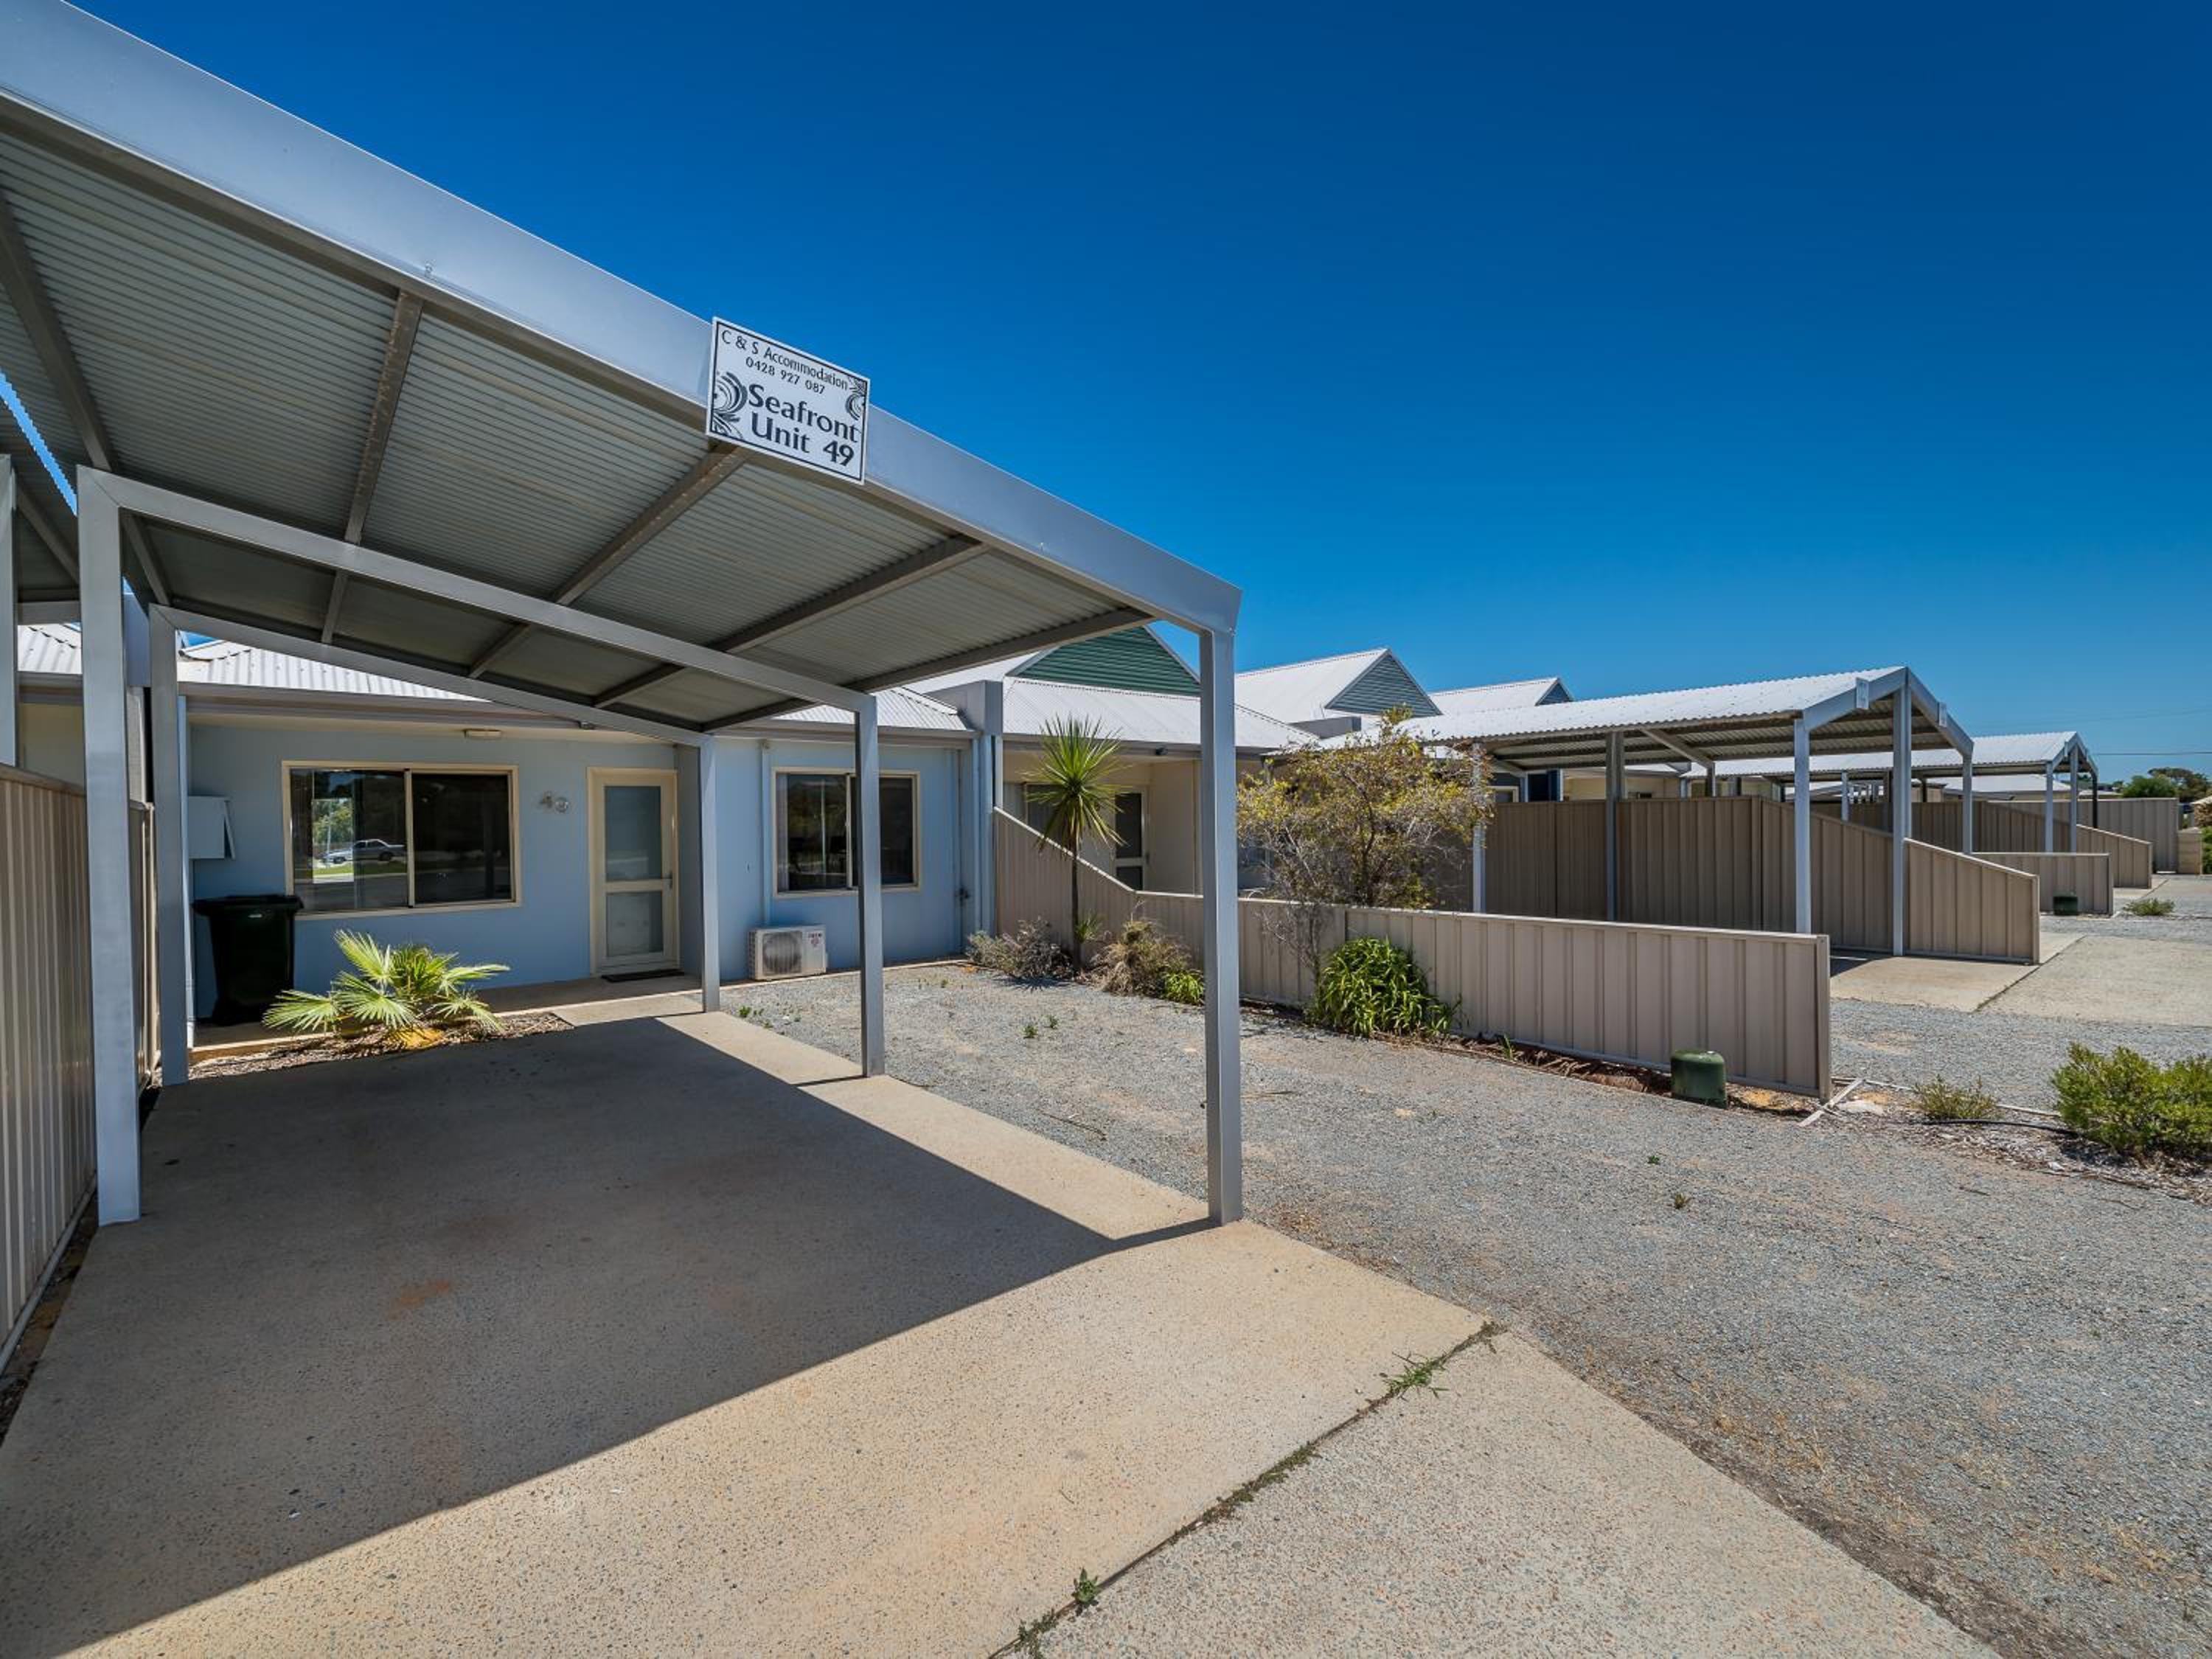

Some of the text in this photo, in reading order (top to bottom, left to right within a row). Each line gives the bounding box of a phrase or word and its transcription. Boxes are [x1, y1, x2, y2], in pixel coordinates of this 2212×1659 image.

[722, 330, 847, 390] C & S Accommodation
[745, 356, 825, 395] 0428 927 087
[748, 383, 860, 443] Seafront
[751, 411, 855, 467] Unit 49
